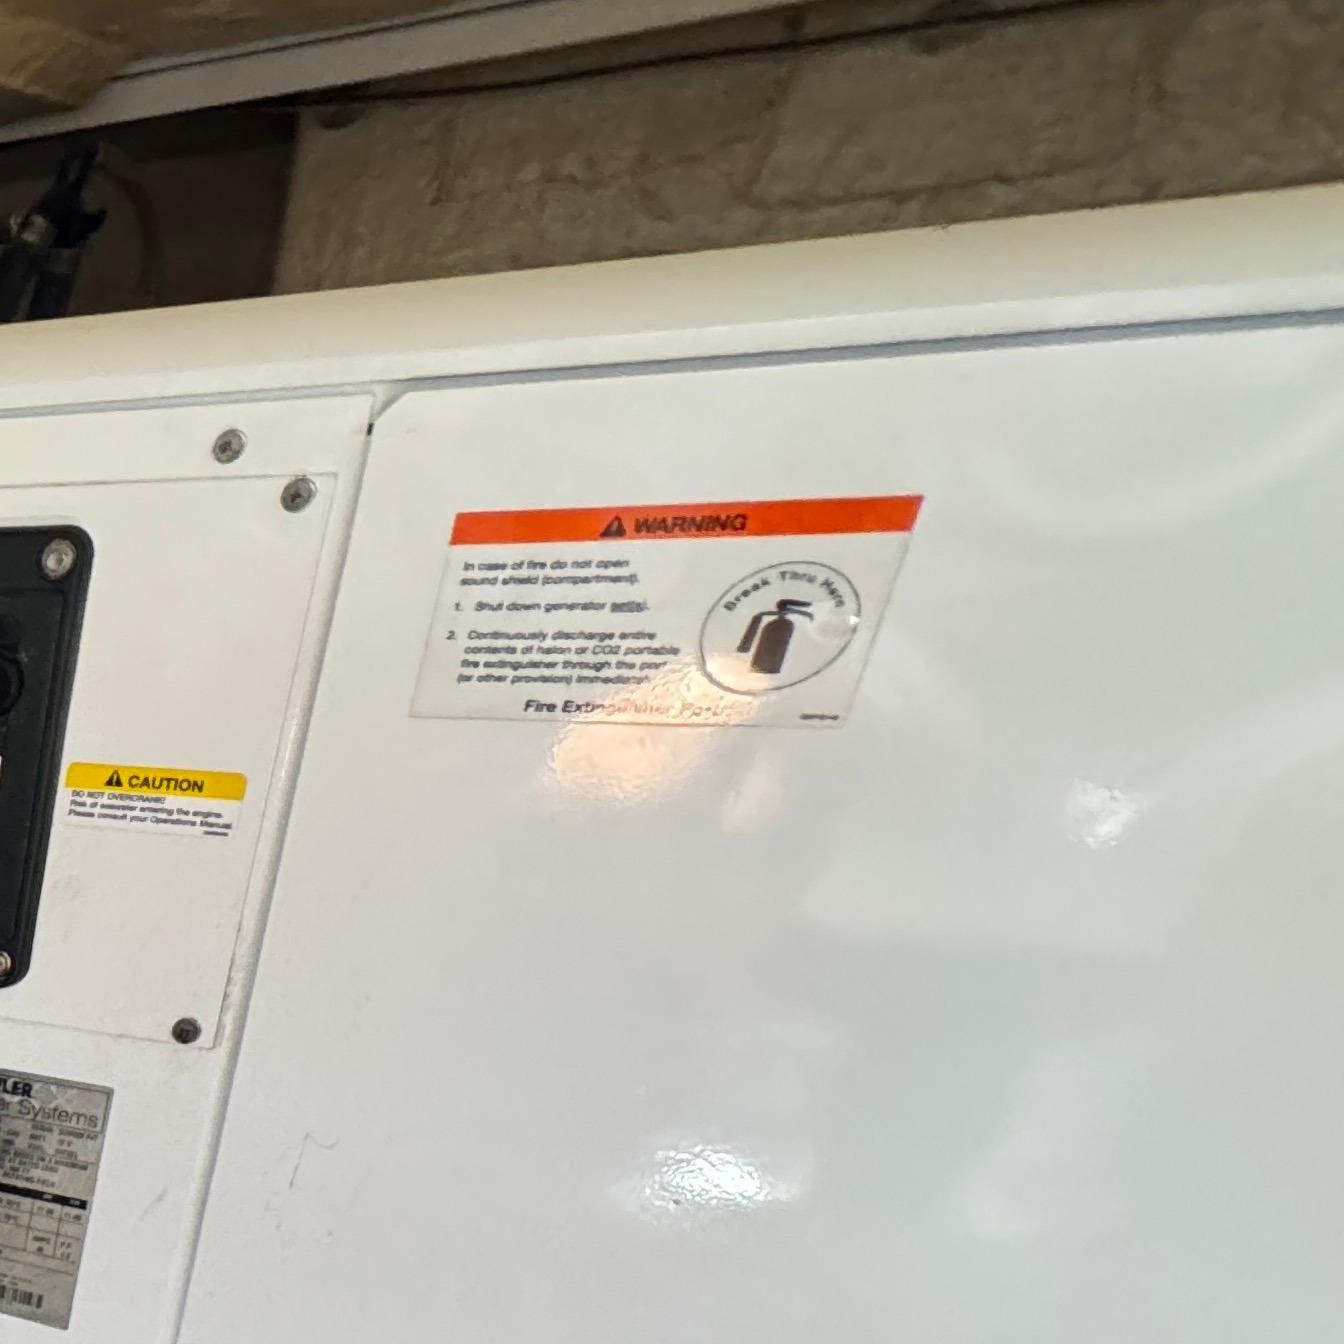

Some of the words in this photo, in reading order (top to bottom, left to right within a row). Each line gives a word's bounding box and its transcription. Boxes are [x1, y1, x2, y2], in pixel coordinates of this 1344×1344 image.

[634, 514, 747, 534] WARNING
[510, 560, 525, 570] of
[527, 560, 547, 570] fire
[550, 560, 567, 570] do
[571, 560, 592, 569] not
[595, 560, 630, 571] open
[474, 600, 505, 611] Shut
[506, 601, 542, 611] down
[543, 601, 608, 613] generator
[521, 645, 535, 655] of
[523, 700, 558, 713] Fire
[128, 775, 205, 793] CAUTION
[71, 790, 85, 799] DO
[87, 791, 106, 800] NOT
[175, 807, 191, 816] the
[17, 1098, 99, 1129] Systems
